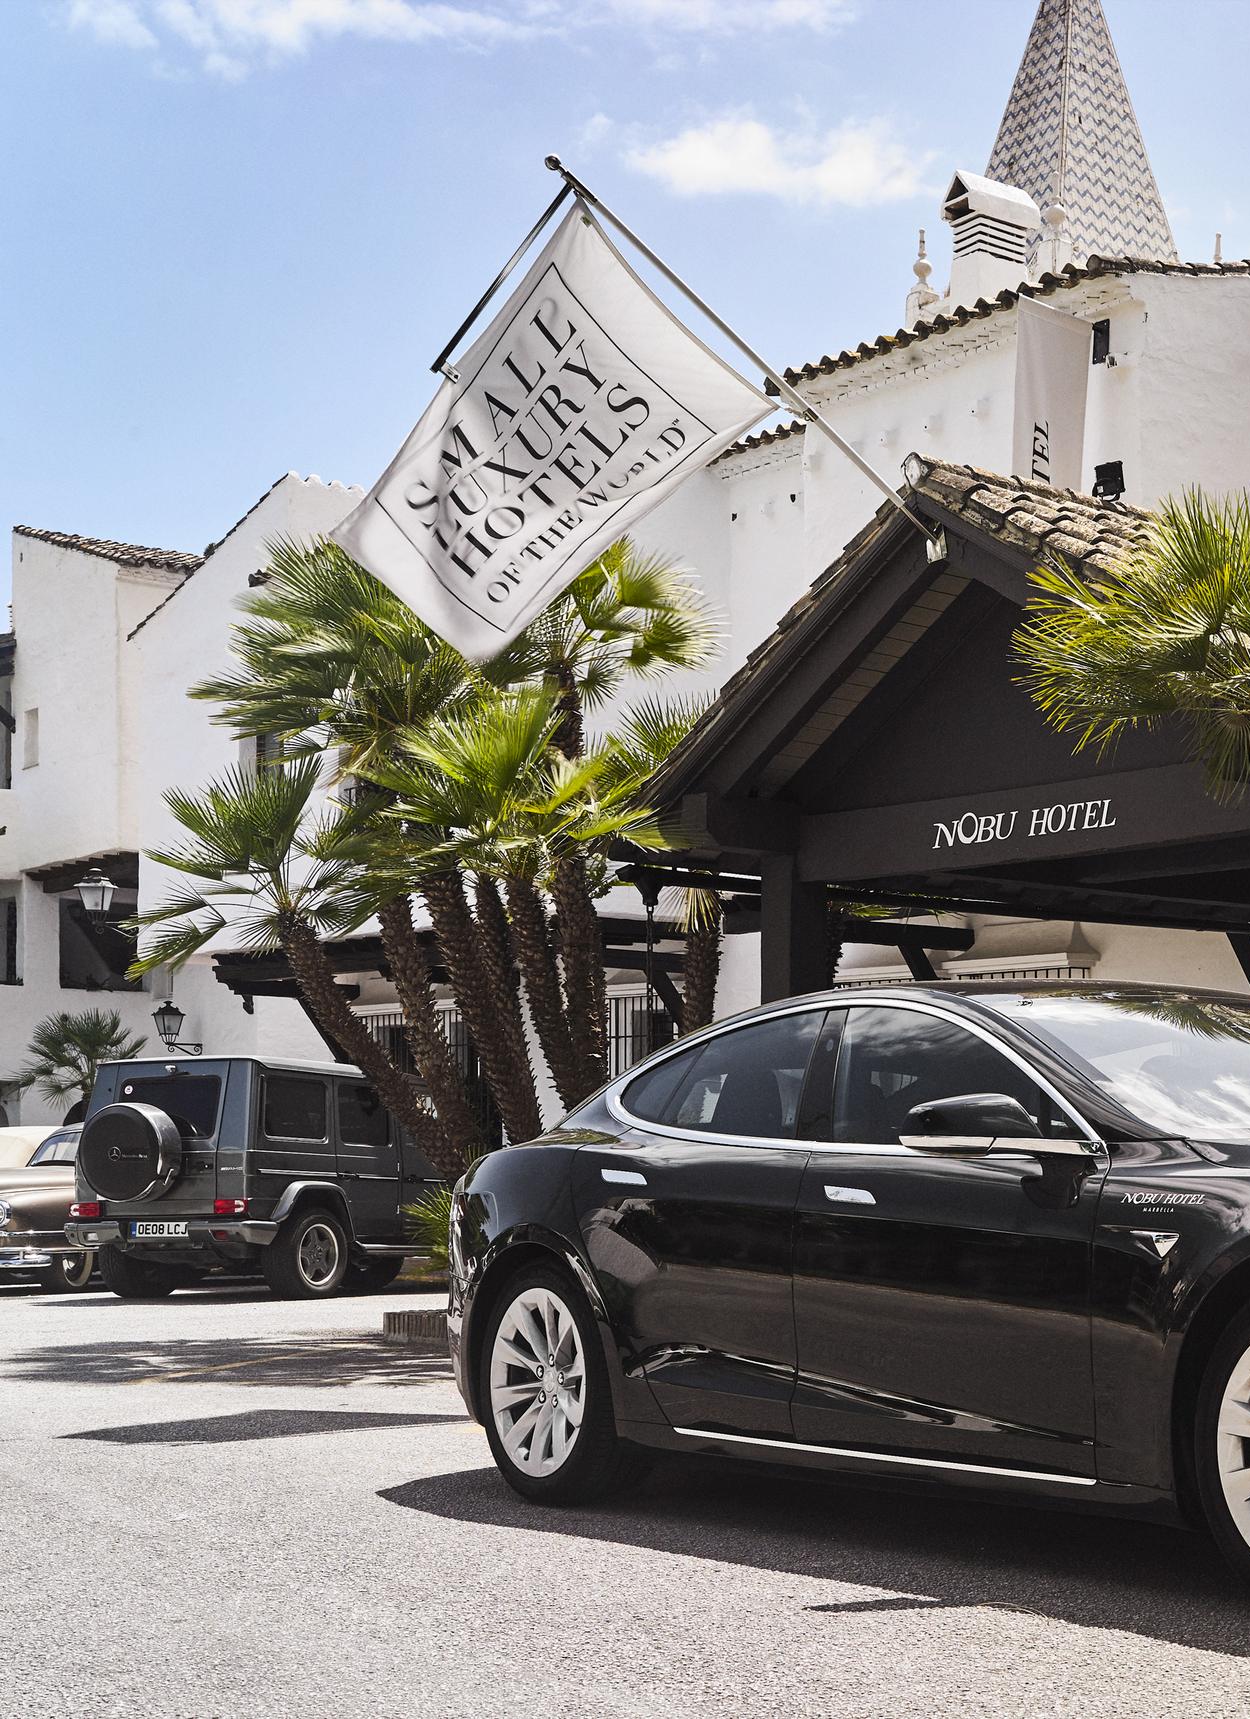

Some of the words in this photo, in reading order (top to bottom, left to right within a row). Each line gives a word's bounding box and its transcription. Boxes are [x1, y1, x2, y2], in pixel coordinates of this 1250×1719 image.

[404, 309, 577, 531] SMALL
[432, 338, 607, 552] LUXURY
[449, 381, 651, 578] HOTELS
[486, 562, 521, 603] OF
[520, 509, 584, 561] THE
[932, 811, 1019, 850] NOBU
[1028, 799, 1117, 837] HOTEL
[167, 1223, 188, 1235] LCJ
[1121, 1192, 1163, 1205] NOBU
[1163, 1193, 1206, 1205] HOTEL
